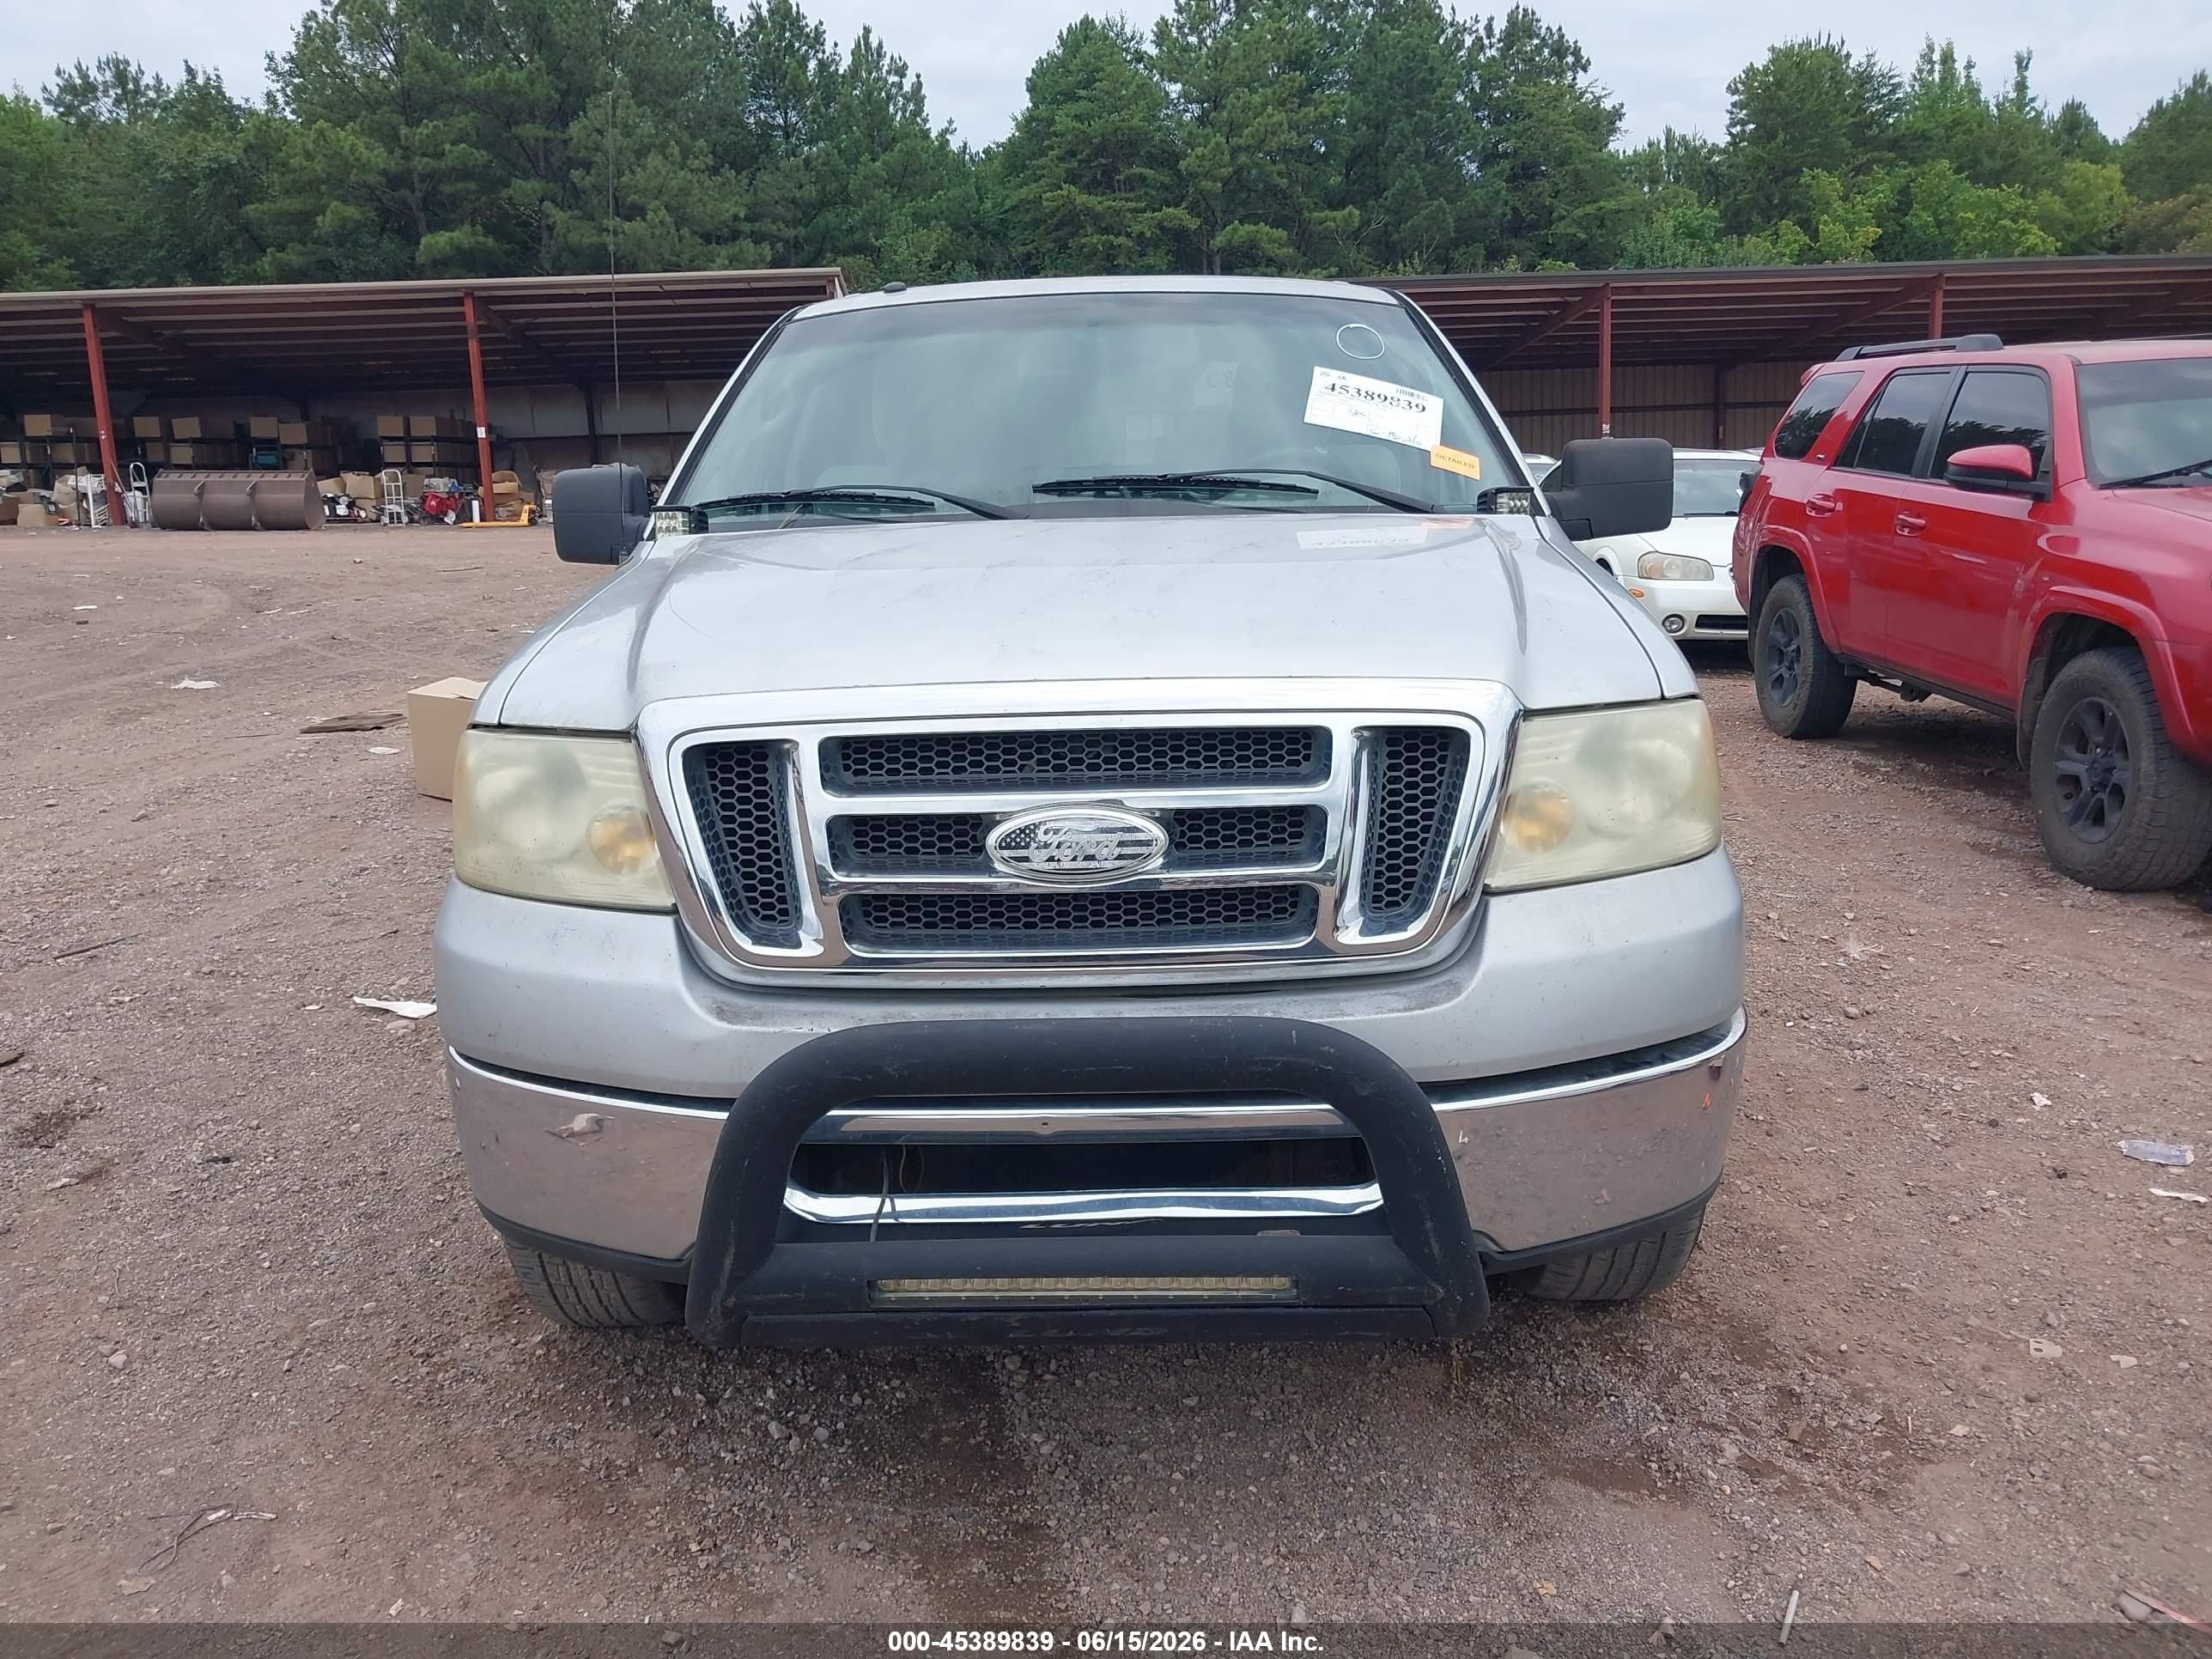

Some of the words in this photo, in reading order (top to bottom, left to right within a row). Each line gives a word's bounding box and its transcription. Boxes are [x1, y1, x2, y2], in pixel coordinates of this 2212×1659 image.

[1324, 382, 1426, 413] 45389839
[1435, 453, 1475, 470] DETAILED
[1029, 823, 1124, 863] Ford
